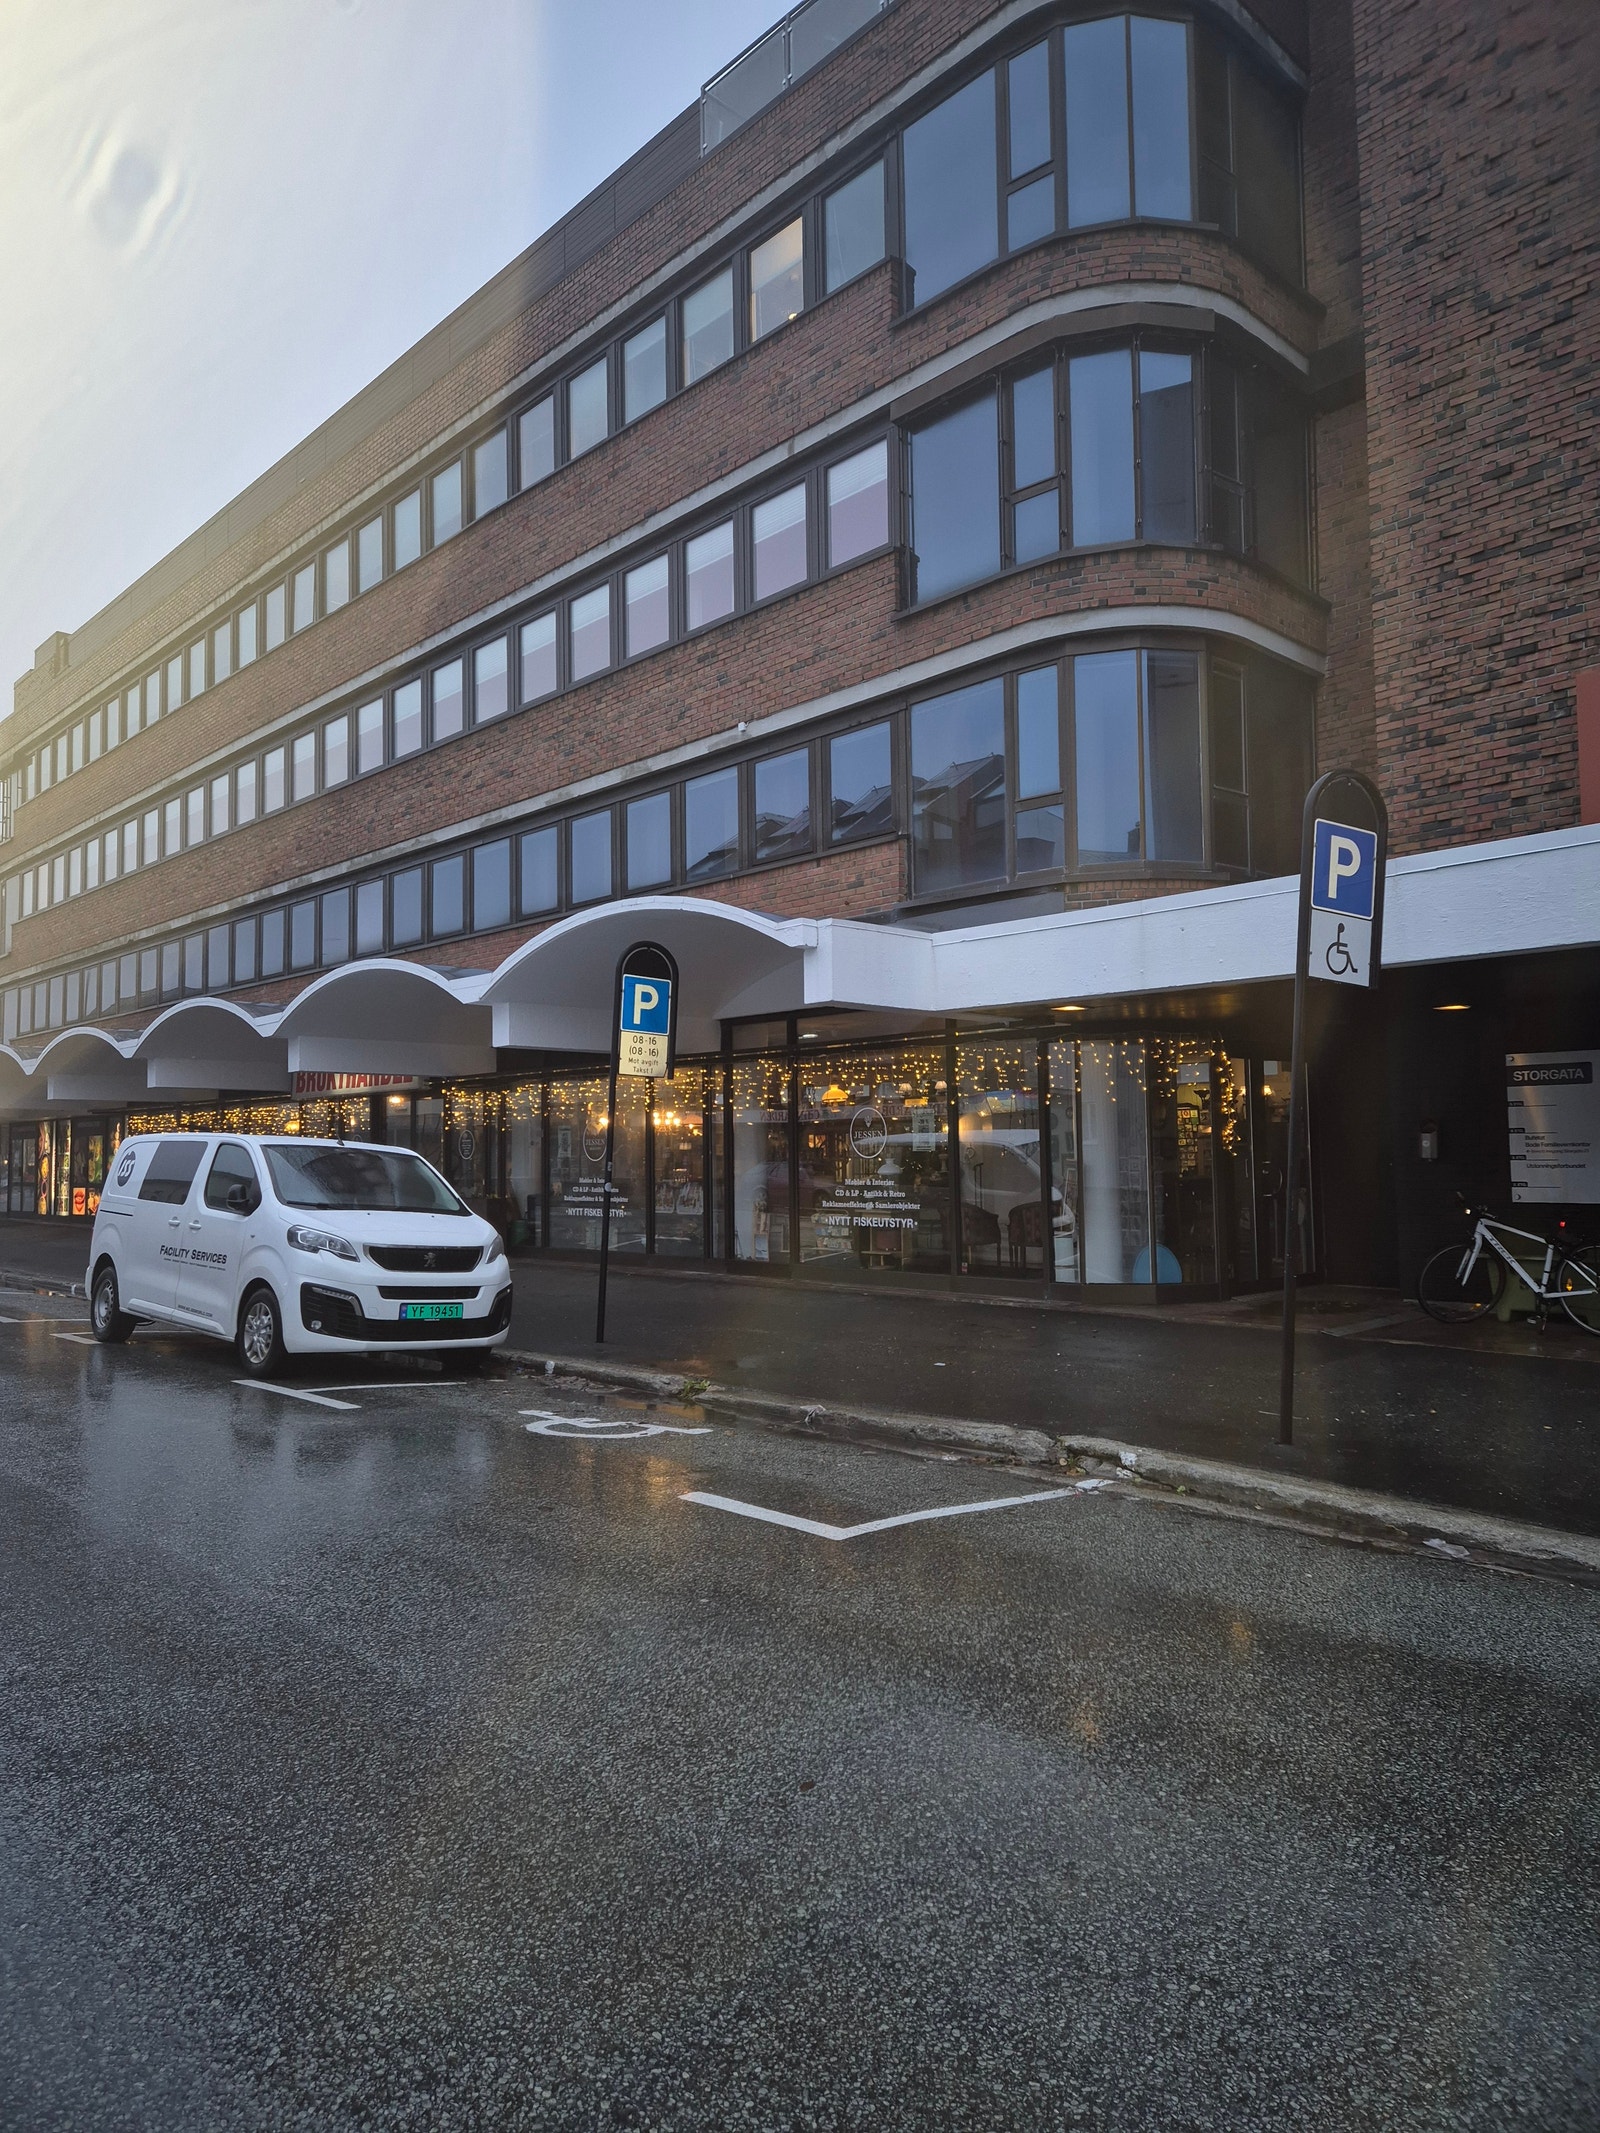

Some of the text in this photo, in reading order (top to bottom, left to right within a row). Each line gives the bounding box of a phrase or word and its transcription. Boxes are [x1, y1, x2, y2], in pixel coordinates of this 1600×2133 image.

[1328, 835, 1361, 899] P
[633, 984, 659, 1025] P
[642, 1059, 659, 1067] avgift
[633, 1066, 649, 1074] Takst
[1513, 1068, 1585, 1081] STORGATA
[853, 1130, 883, 1139] JESSEN
[160, 1244, 191, 1258] FACILITY
[191, 1249, 227, 1265] SERVICES
[412, 1306, 459, 1317] YF 19451
